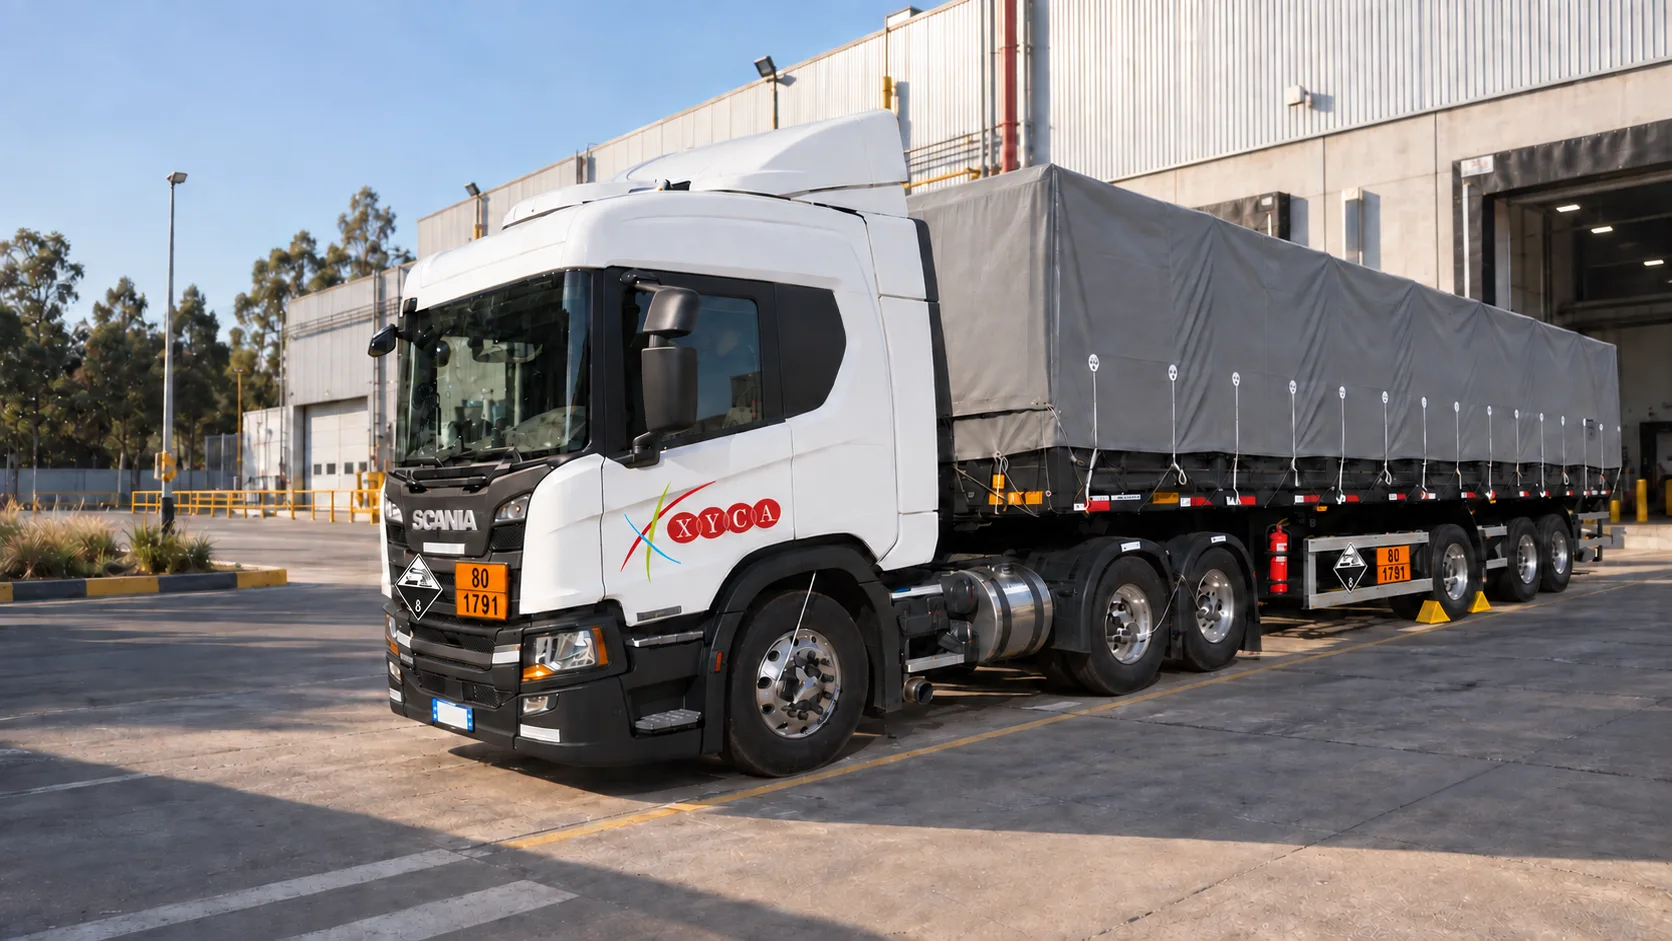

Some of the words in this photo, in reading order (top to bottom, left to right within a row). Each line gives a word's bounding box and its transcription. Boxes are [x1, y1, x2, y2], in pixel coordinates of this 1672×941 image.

[412, 509, 477, 531] SCANIA
[676, 504, 777, 539] XYCA
[1388, 549, 1400, 562] 80
[472, 567, 489, 588] 80
[1383, 566, 1405, 581] 1791
[415, 599, 421, 612] 8
[463, 593, 497, 615] 1791
